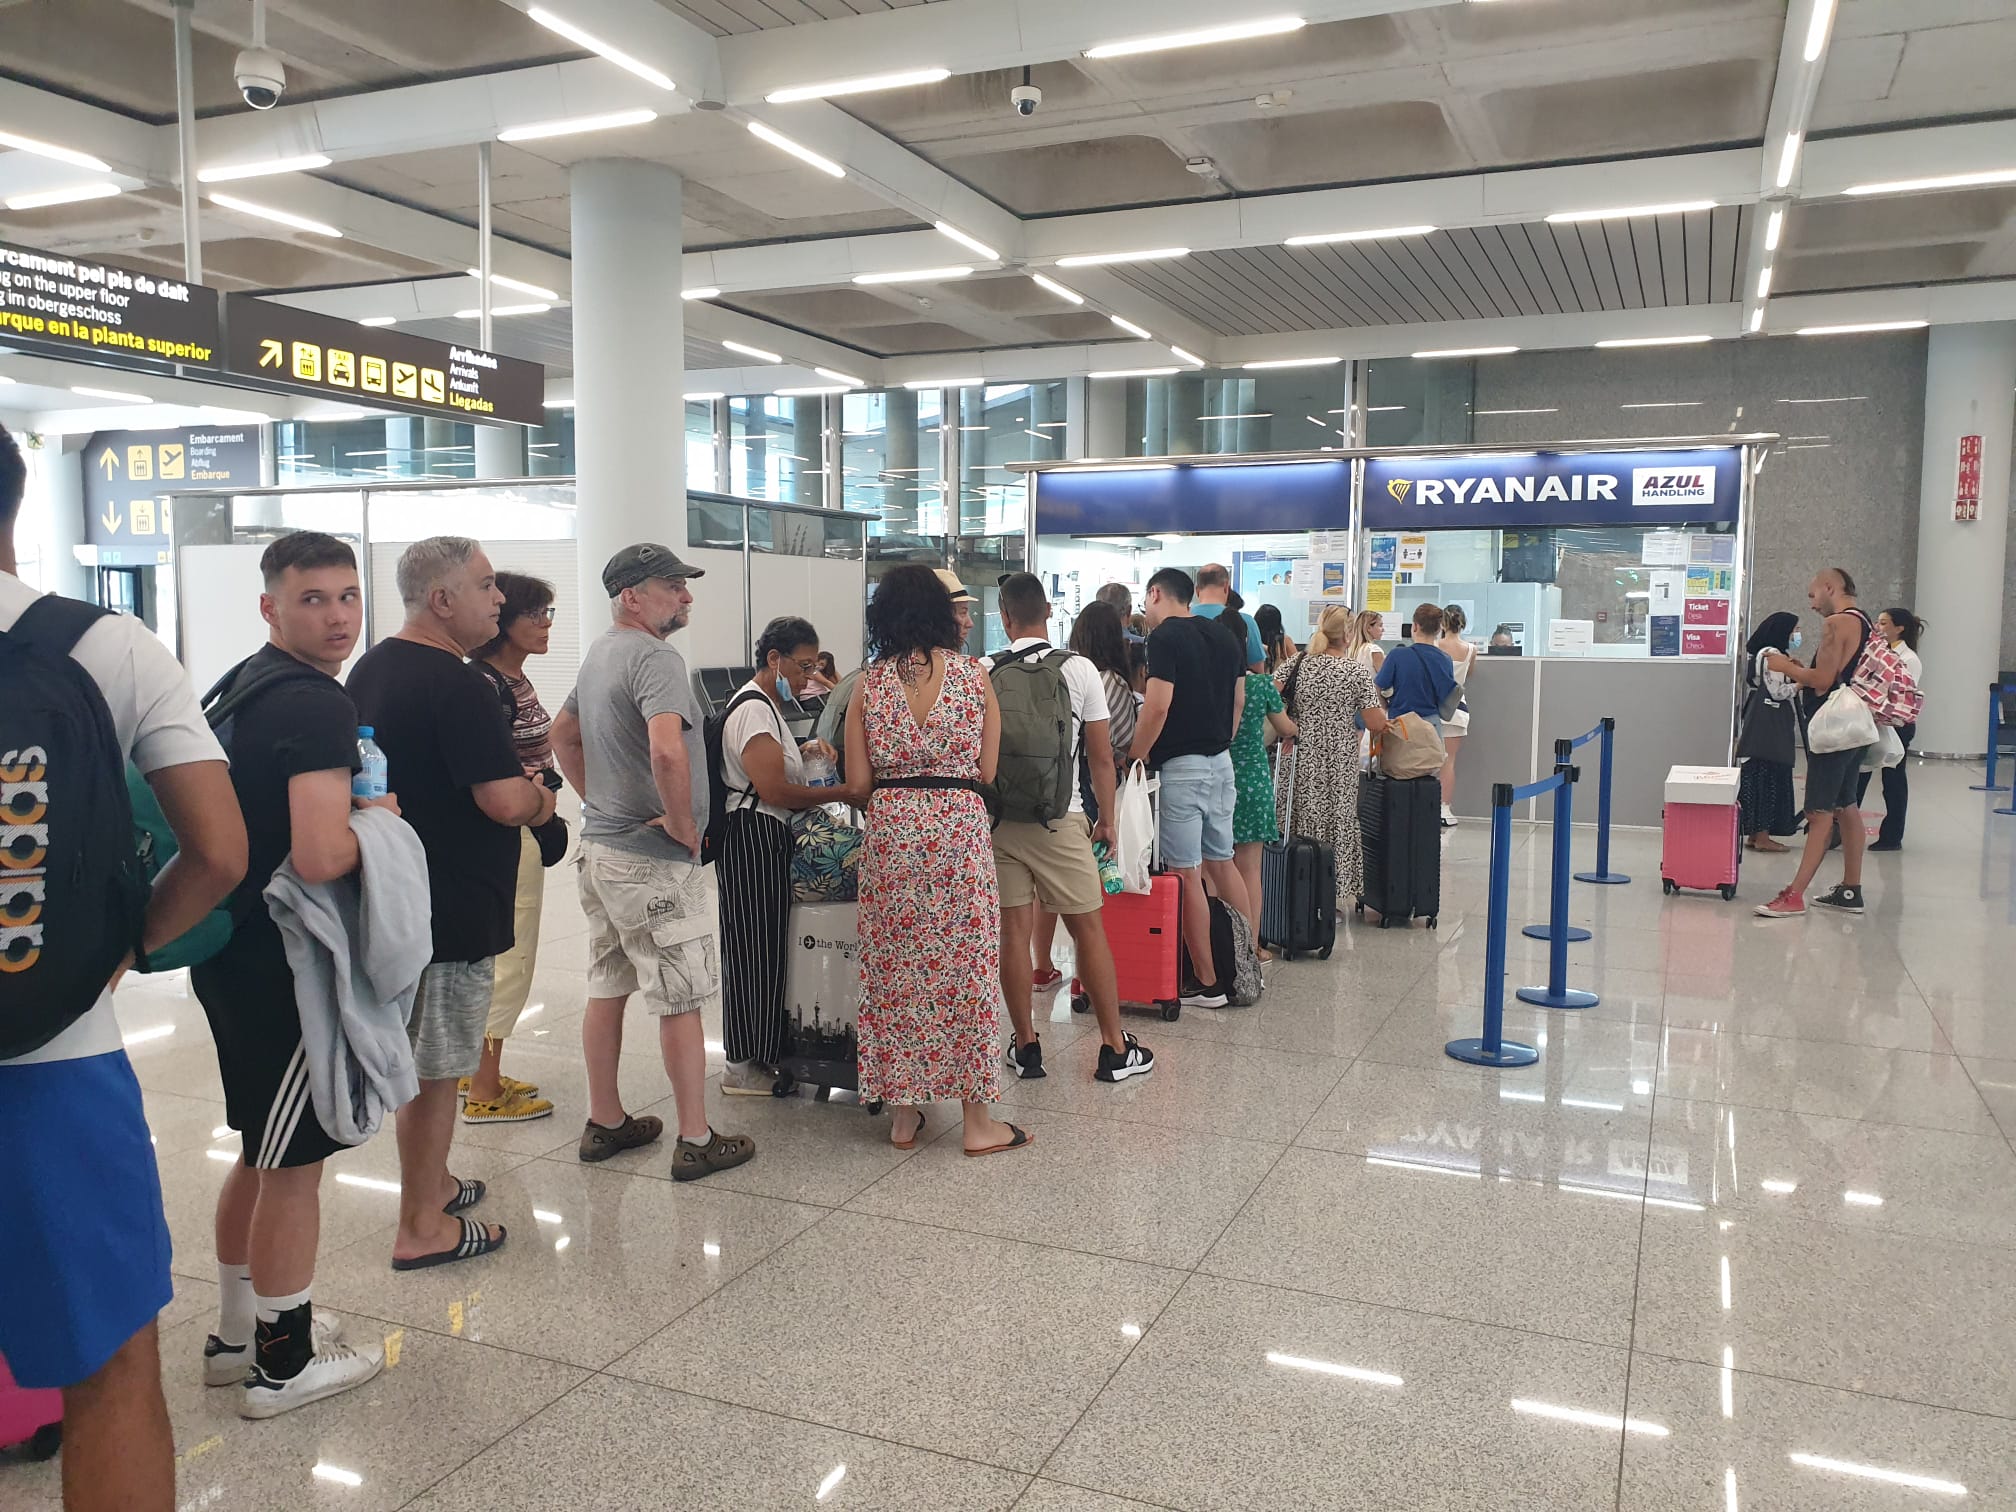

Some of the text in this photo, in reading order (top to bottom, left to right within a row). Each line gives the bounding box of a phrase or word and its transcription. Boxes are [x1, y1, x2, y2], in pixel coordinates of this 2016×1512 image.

[77, 265, 105, 285] pel
[134, 276, 155, 294] de
[14, 273, 32, 288] on
[34, 275, 57, 293] the
[59, 281, 98, 301] upper
[99, 287, 130, 308] floor
[8, 289, 25, 307] im
[28, 294, 122, 325] obergeschoss
[48, 320, 70, 337] en
[72, 320, 89, 340] la
[92, 326, 145, 350] planta
[147, 338, 212, 361] superior
[449, 362, 479, 380] Arrivals
[449, 391, 494, 413] Llegadas
[190, 433, 244, 444] Embarcament
[190, 447, 216, 456] Boarding
[191, 470, 230, 480] Embarque
[1643, 475, 1704, 488] AZUL
[1415, 474, 1618, 505] RYANAIR
[1642, 489, 1705, 497] HANDLING
[1688, 603, 1709, 611] Ticket
[1686, 633, 1701, 641] Visa
[816, 939, 833, 949] the
[835, 940, 858, 951] Worl
